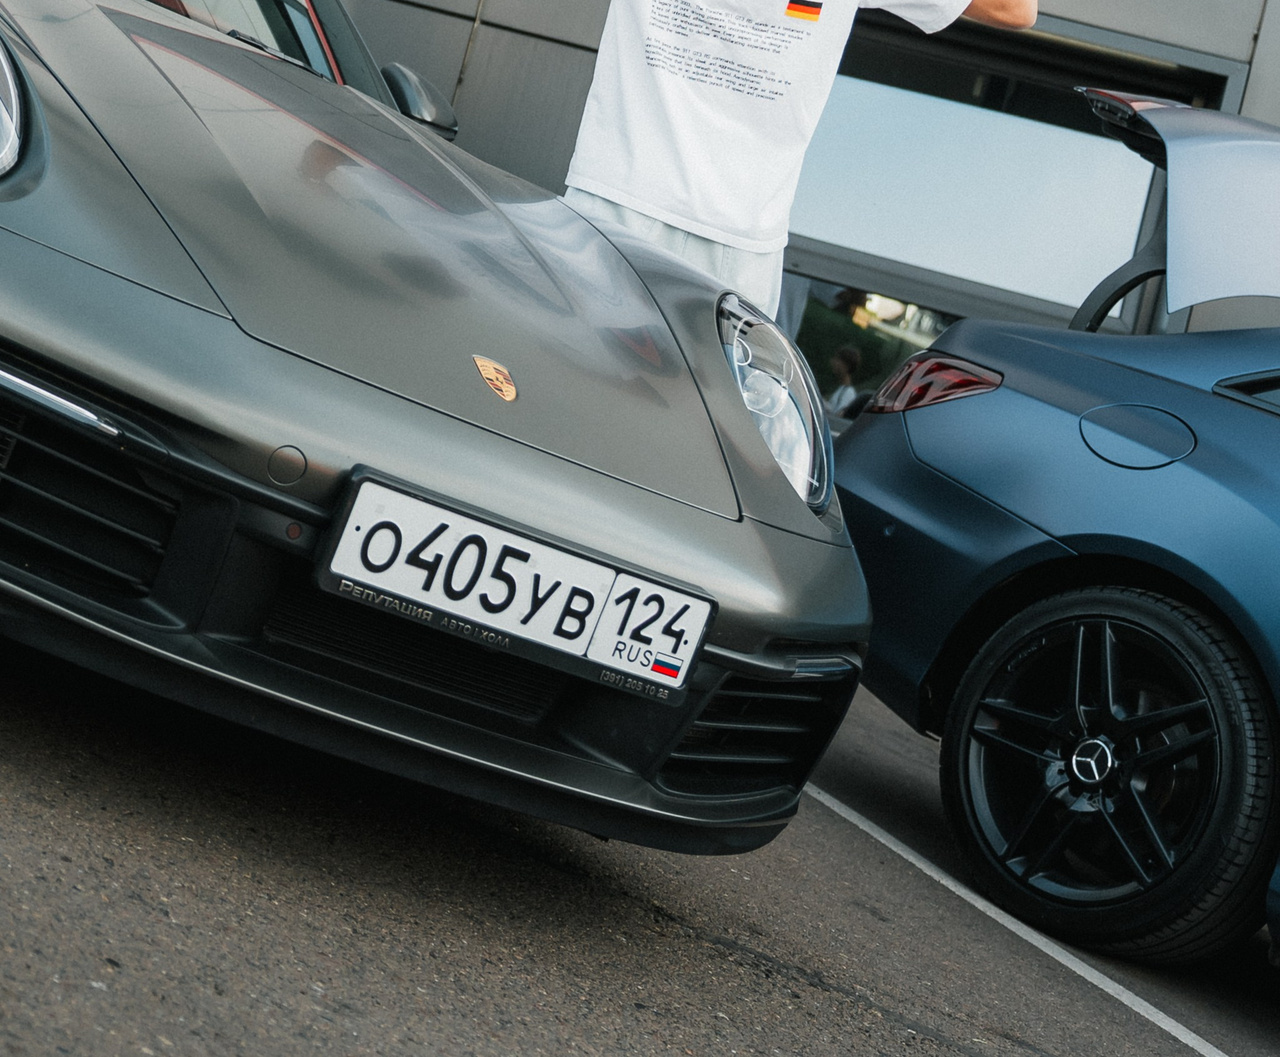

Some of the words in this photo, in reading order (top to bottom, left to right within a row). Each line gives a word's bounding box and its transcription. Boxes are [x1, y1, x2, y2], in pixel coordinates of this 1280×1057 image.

[360, 520, 595, 641] О405УВ
[612, 641, 653, 667] RUS
[615, 586, 691, 654] 124
